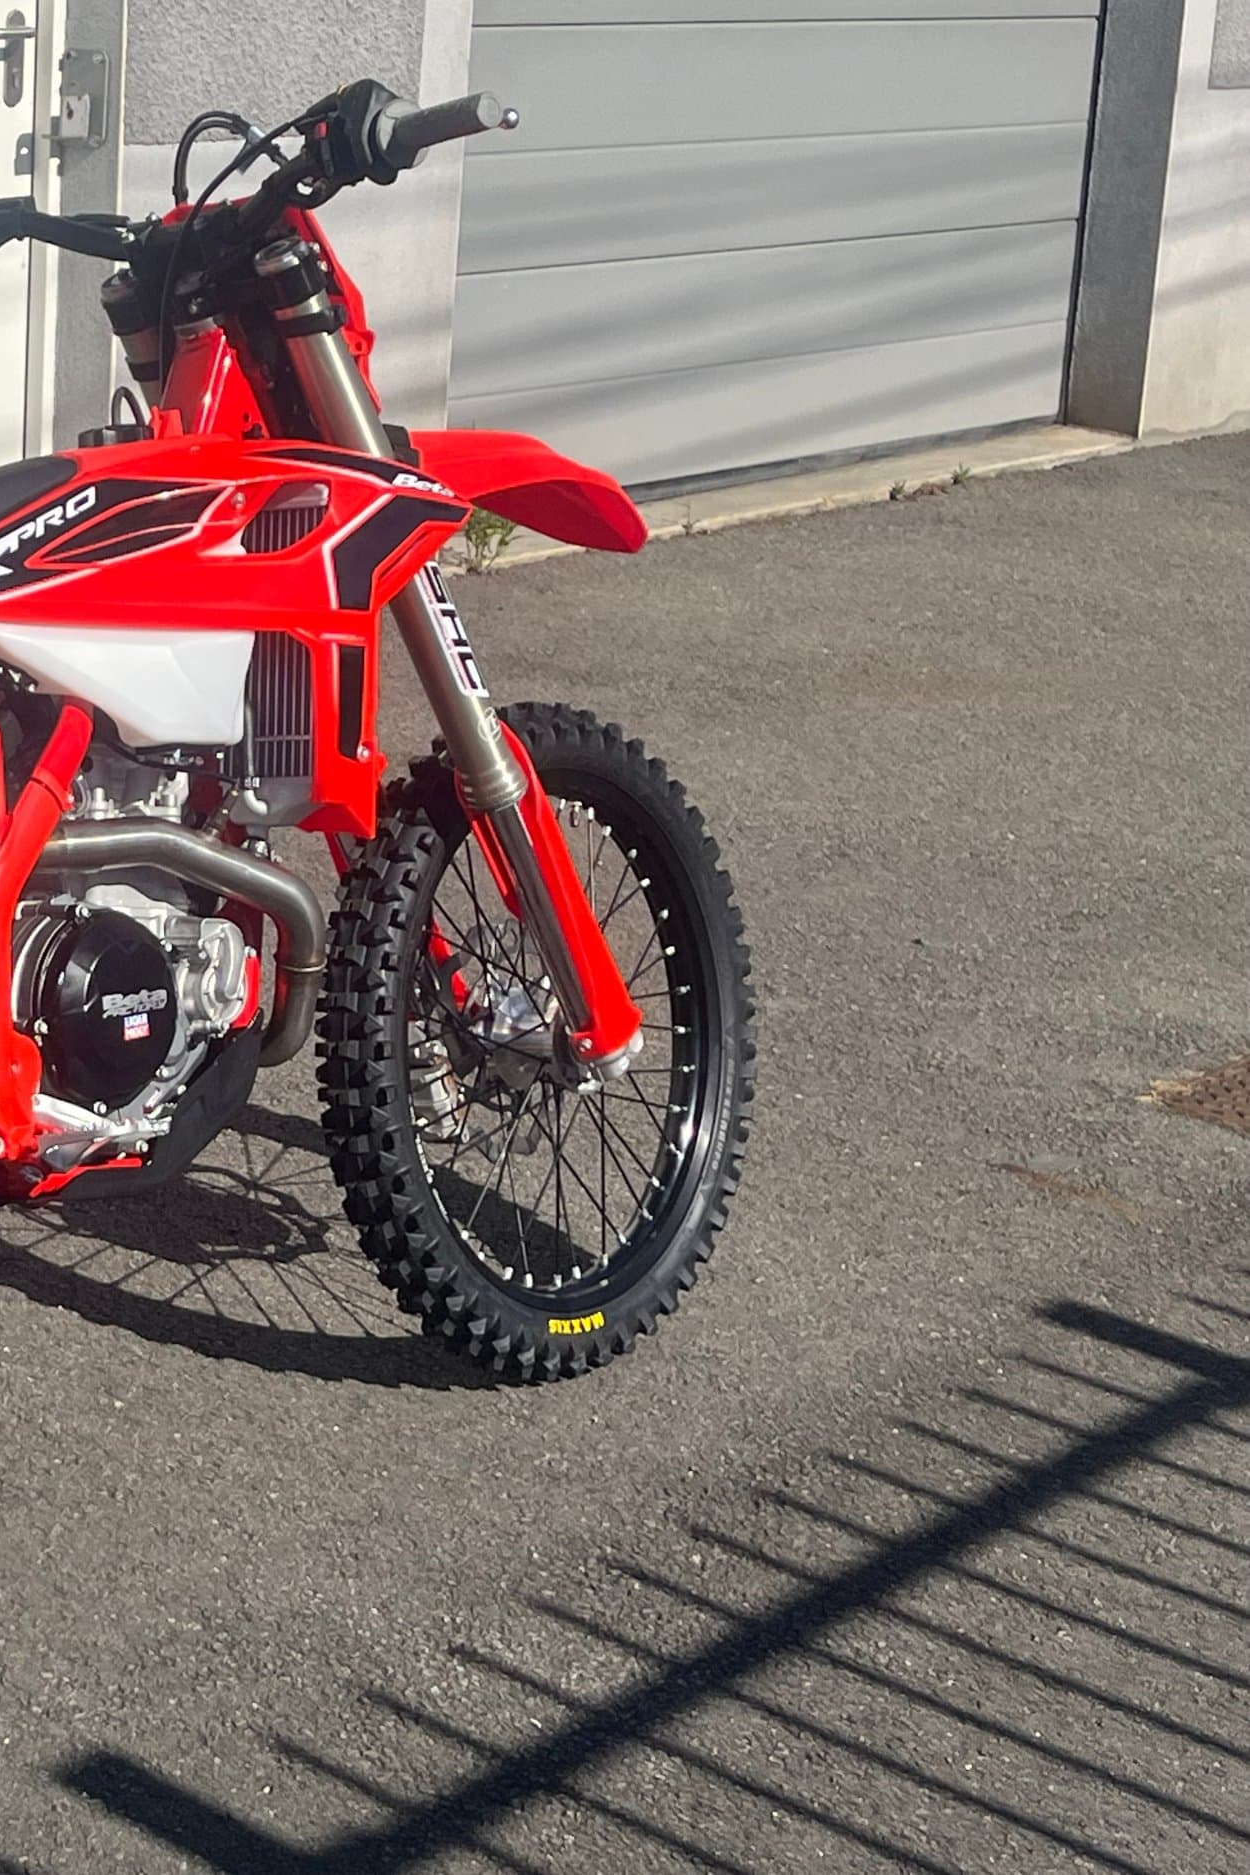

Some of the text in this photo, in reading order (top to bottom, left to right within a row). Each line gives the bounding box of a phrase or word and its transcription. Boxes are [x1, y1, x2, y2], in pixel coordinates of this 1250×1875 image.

[392, 473, 455, 498] Beta
[102, 989, 167, 1011] Beta
[548, 1311, 605, 1335] MAXXIS
